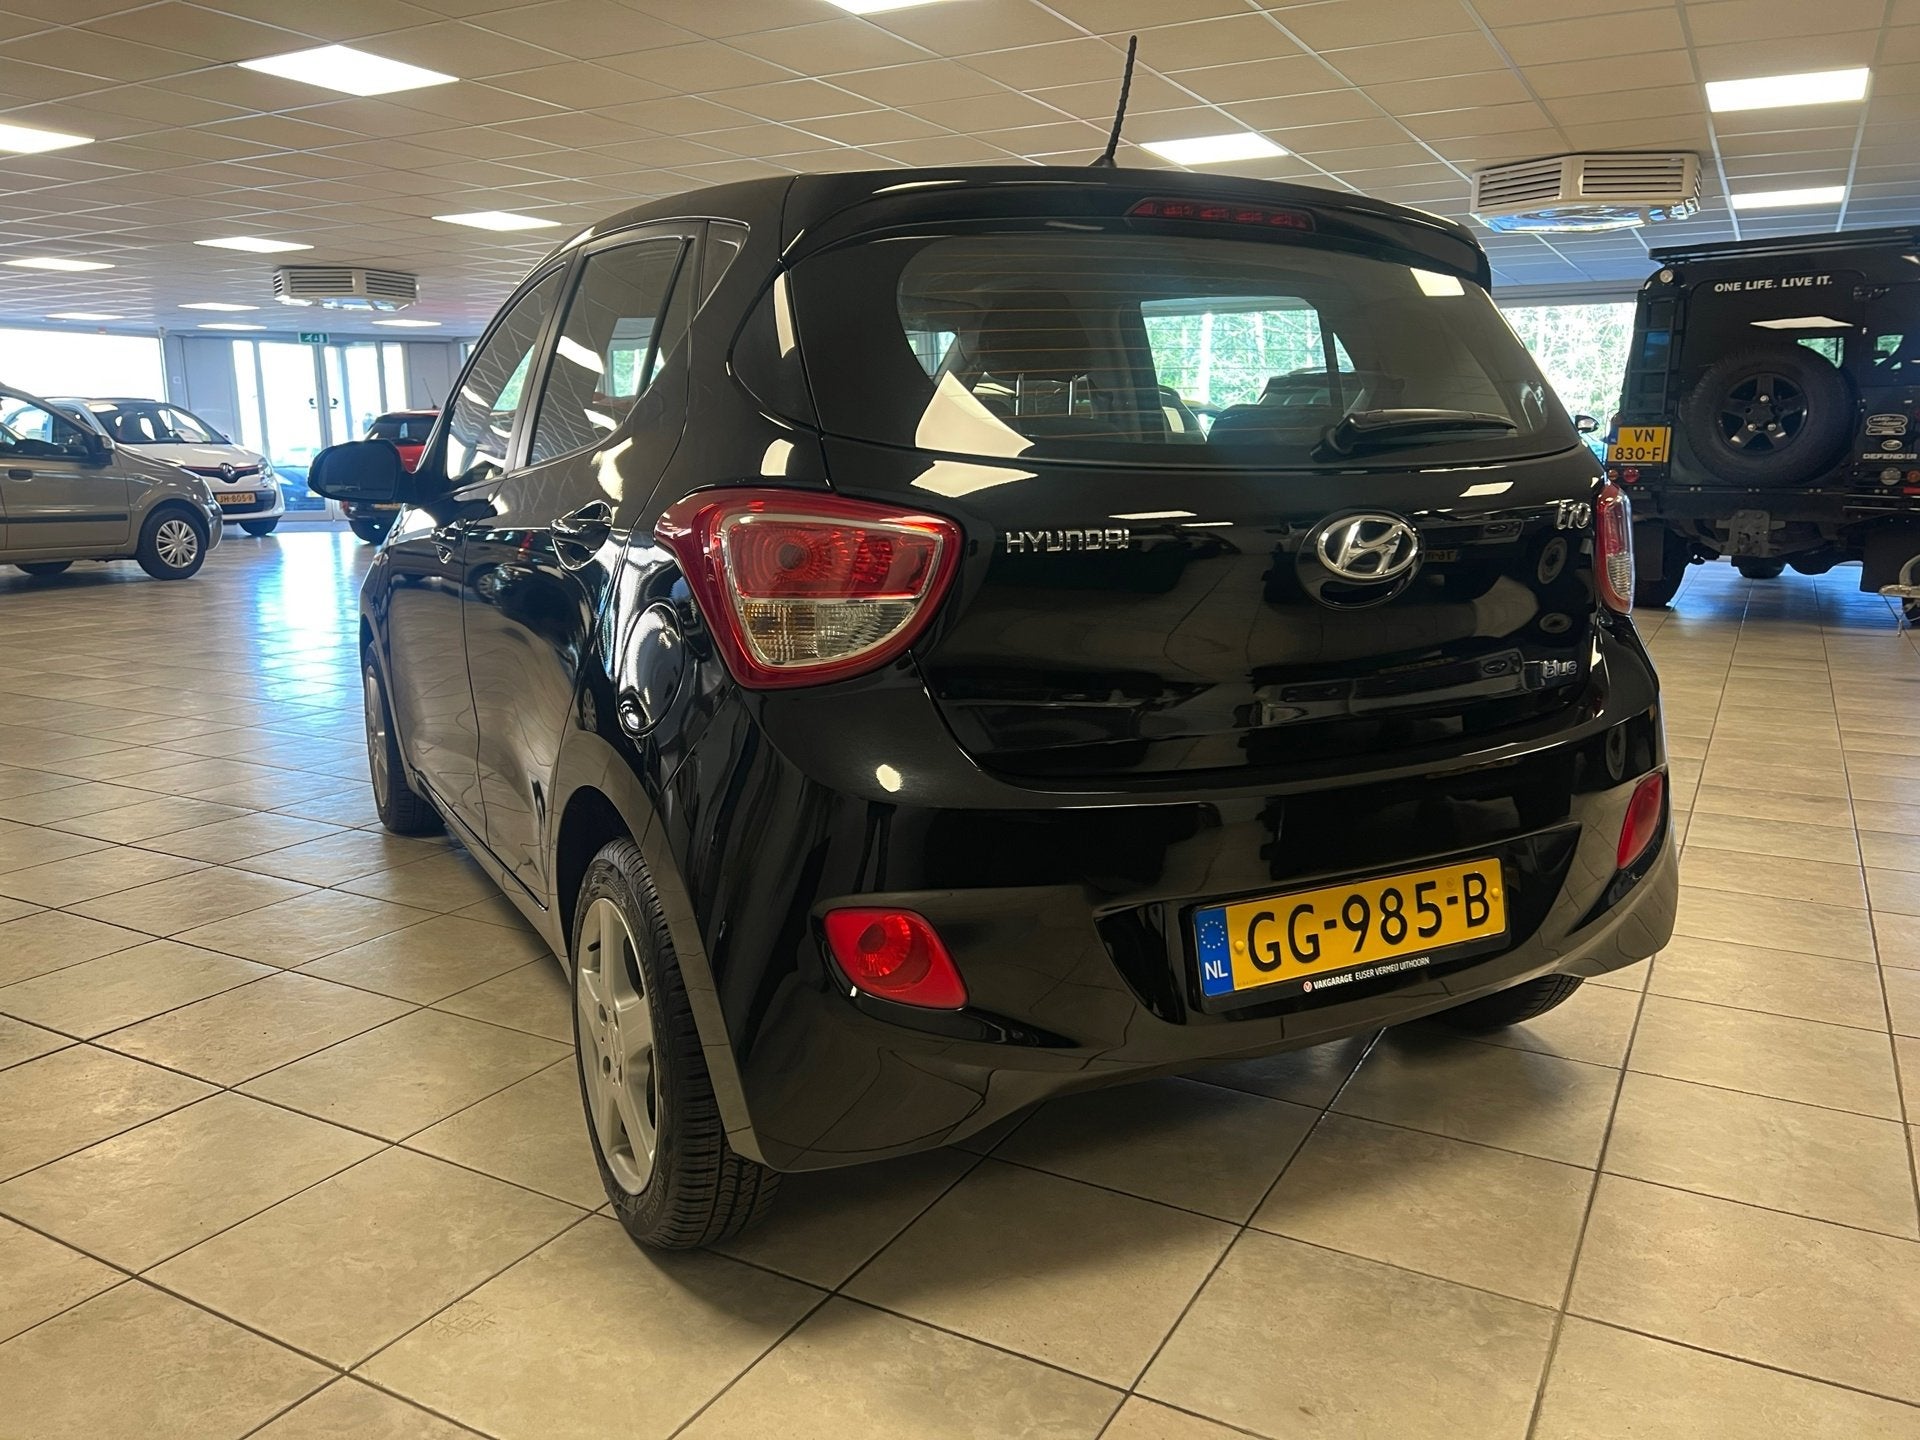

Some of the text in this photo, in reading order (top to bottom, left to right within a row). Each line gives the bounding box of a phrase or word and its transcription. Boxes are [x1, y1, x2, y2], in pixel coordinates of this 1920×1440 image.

[1714, 275, 1833, 293] ONE LIFE. LIVE IT.
[1634, 429, 1655, 442] VN
[1615, 447, 1661, 460] 830-F
[1005, 528, 1130, 553] HYUNDAI
[1543, 659, 1578, 679] blue
[1246, 871, 1493, 973] GG-985-B
[1205, 960, 1229, 981] NL
[1313, 973, 1353, 990] VAKGARAGE
[1355, 968, 1376, 981] EUSER
[1399, 956, 1431, 971] UITHOORN
